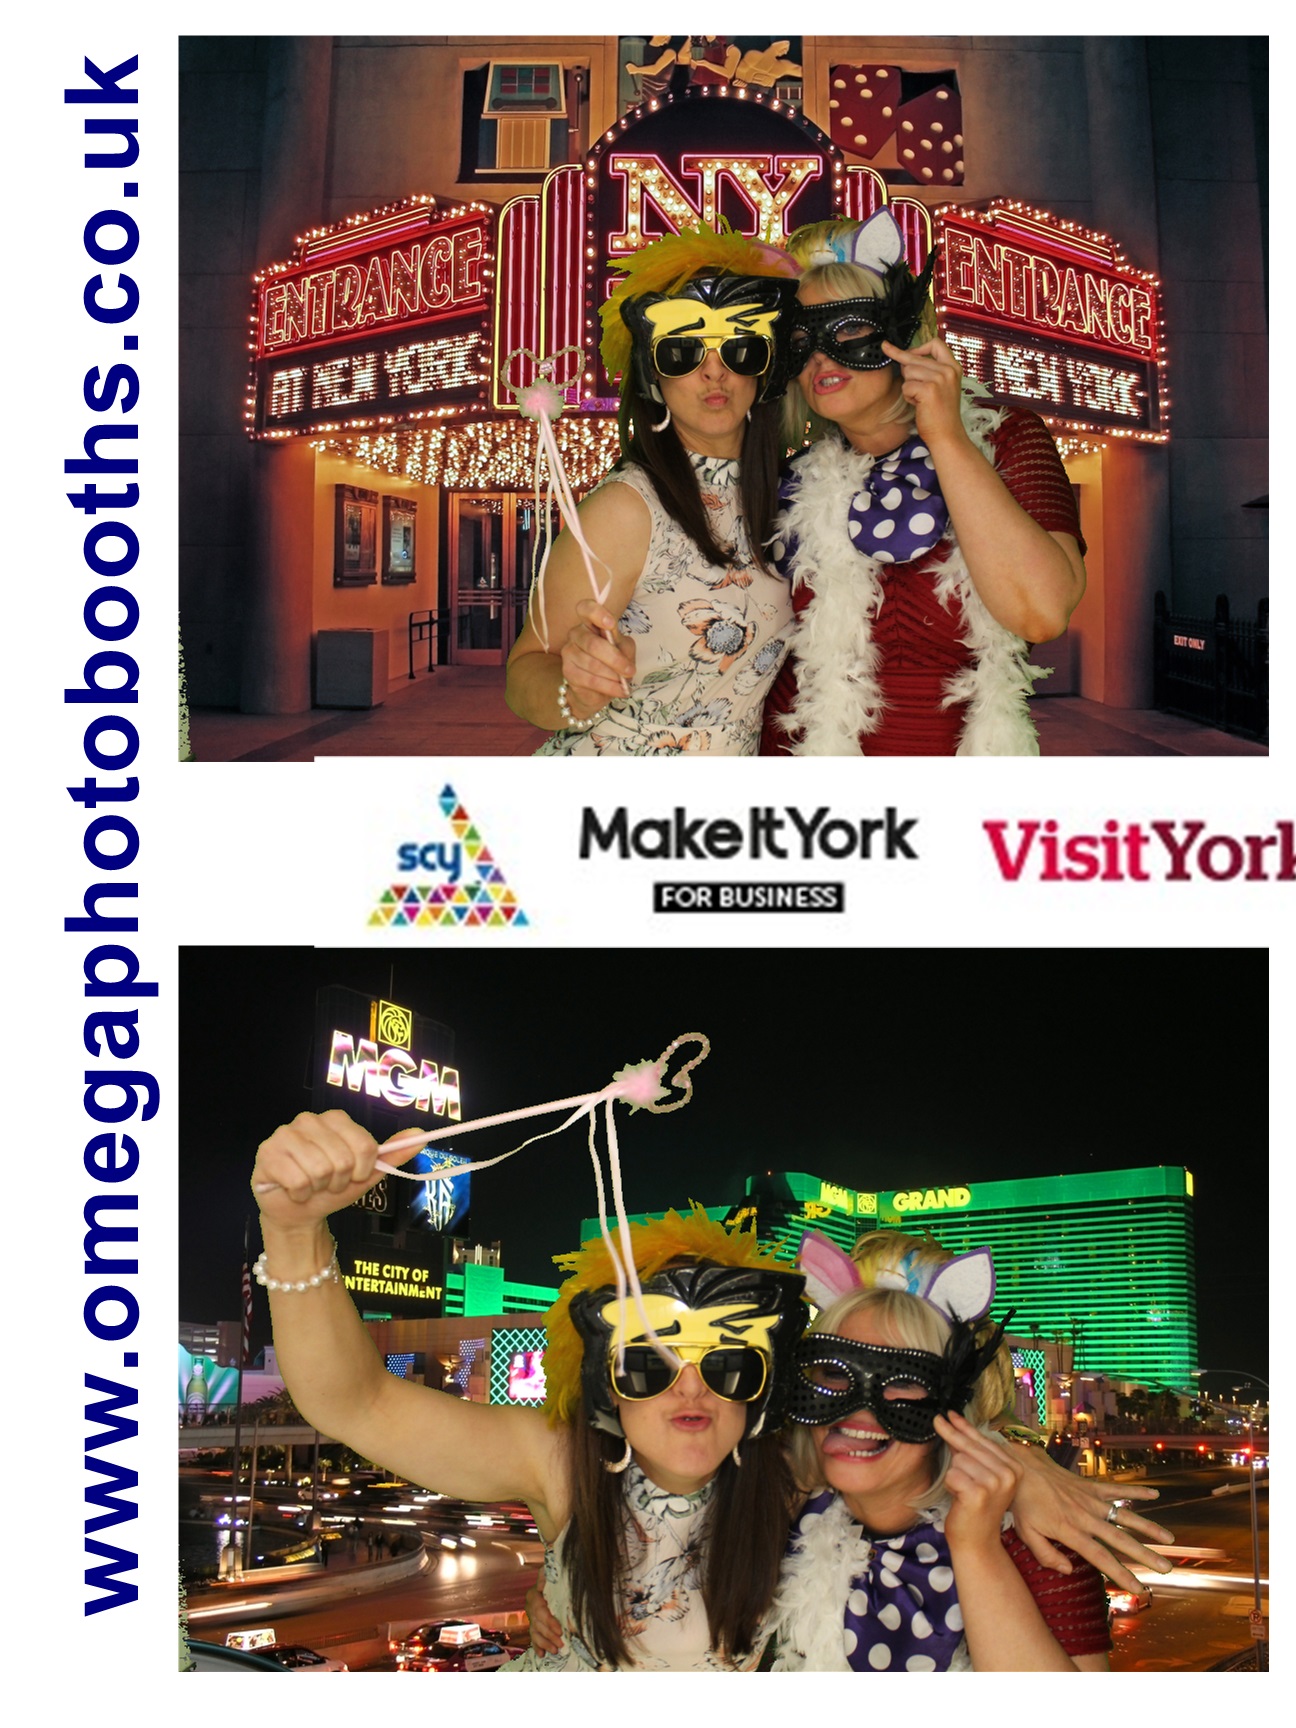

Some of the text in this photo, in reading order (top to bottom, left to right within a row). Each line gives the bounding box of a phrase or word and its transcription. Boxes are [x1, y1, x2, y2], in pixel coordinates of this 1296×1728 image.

[609, 153, 823, 254] NY
[263, 227, 484, 347] ENTRANCE
[943, 226, 1153, 350] ENTRANCE
[271, 331, 482, 419] AT NEW YORK
[1067, 356, 1144, 419] YORK
[1173, 634, 1206, 651] EXIT ONLY
[326, 1029, 463, 1121] MGM
[893, 1186, 971, 1211] GRAND
[342, 1275, 443, 1300] NTERTAINMENT
[354, 1260, 429, 1283] THE CITY OF
